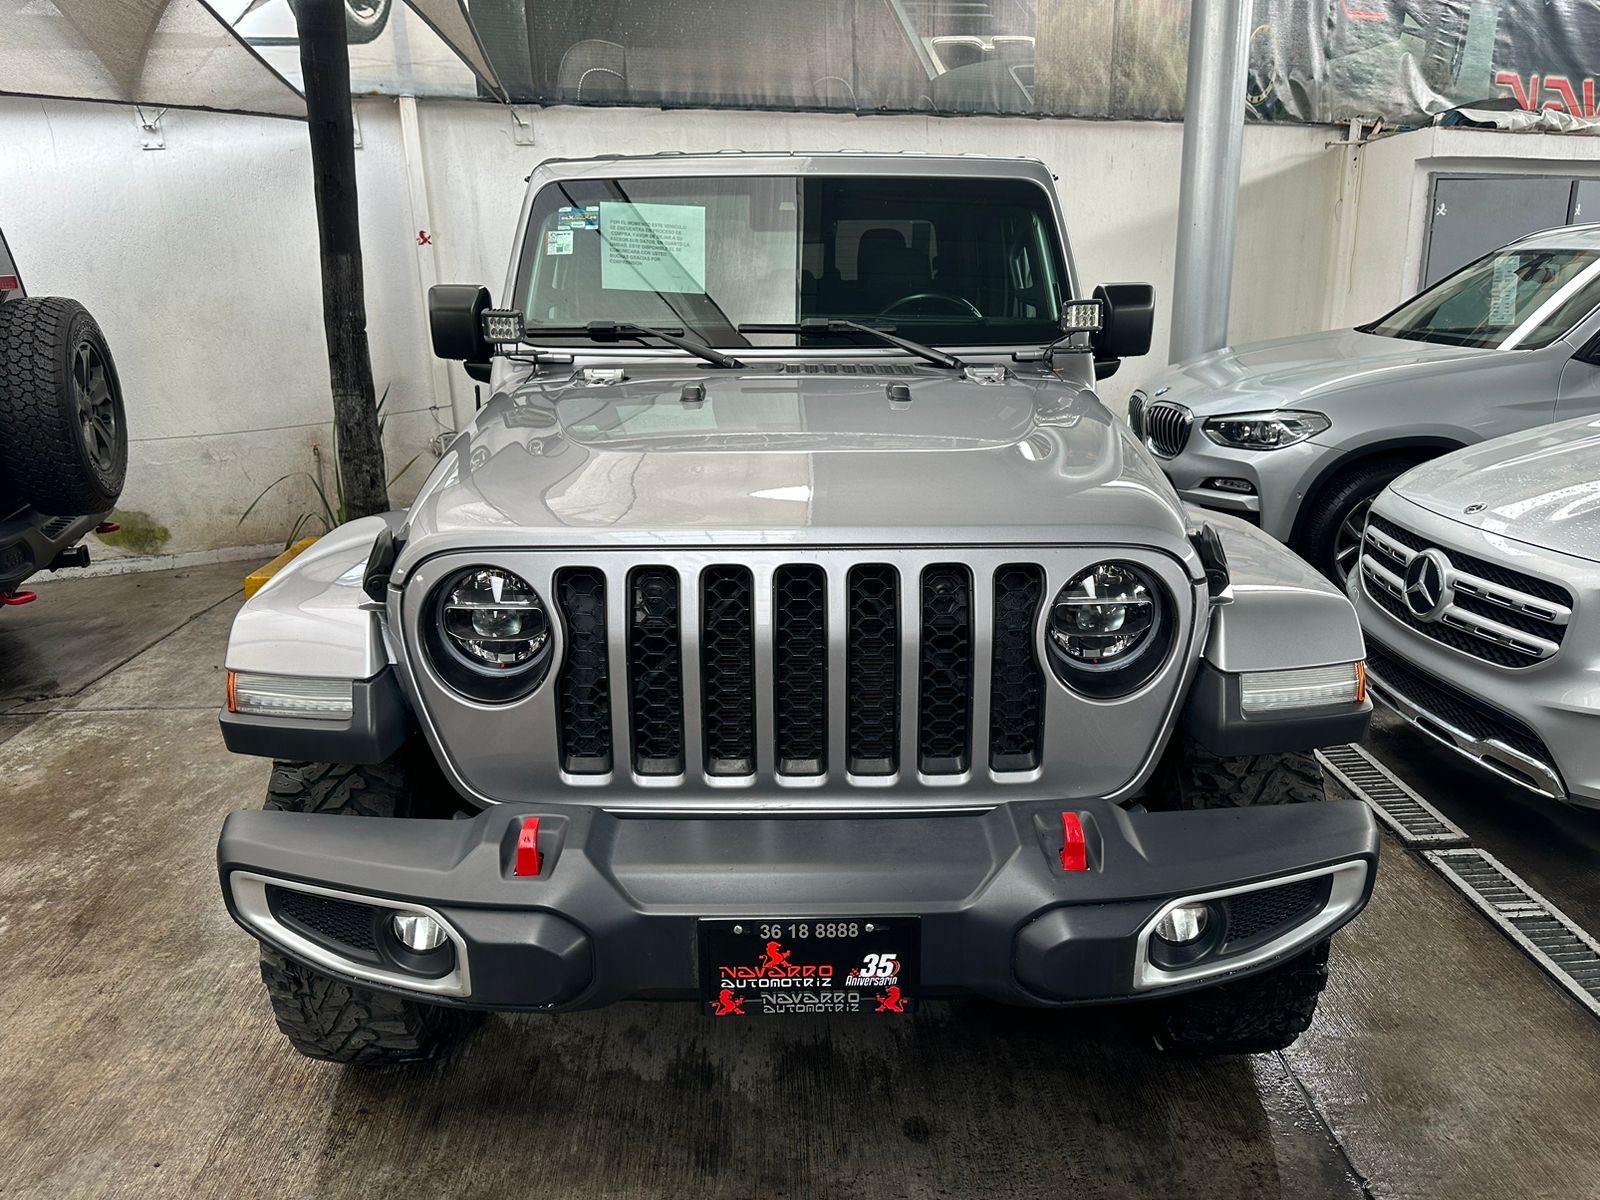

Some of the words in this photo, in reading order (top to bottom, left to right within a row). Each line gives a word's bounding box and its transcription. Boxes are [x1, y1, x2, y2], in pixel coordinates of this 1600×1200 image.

[760, 924, 782, 939] 36
[788, 924, 809, 938] 18
[815, 923, 859, 938] 8888
[719, 965, 833, 978] NAVARRO
[861, 953, 897, 977] 35
[761, 992, 859, 1004] NAVARRO
